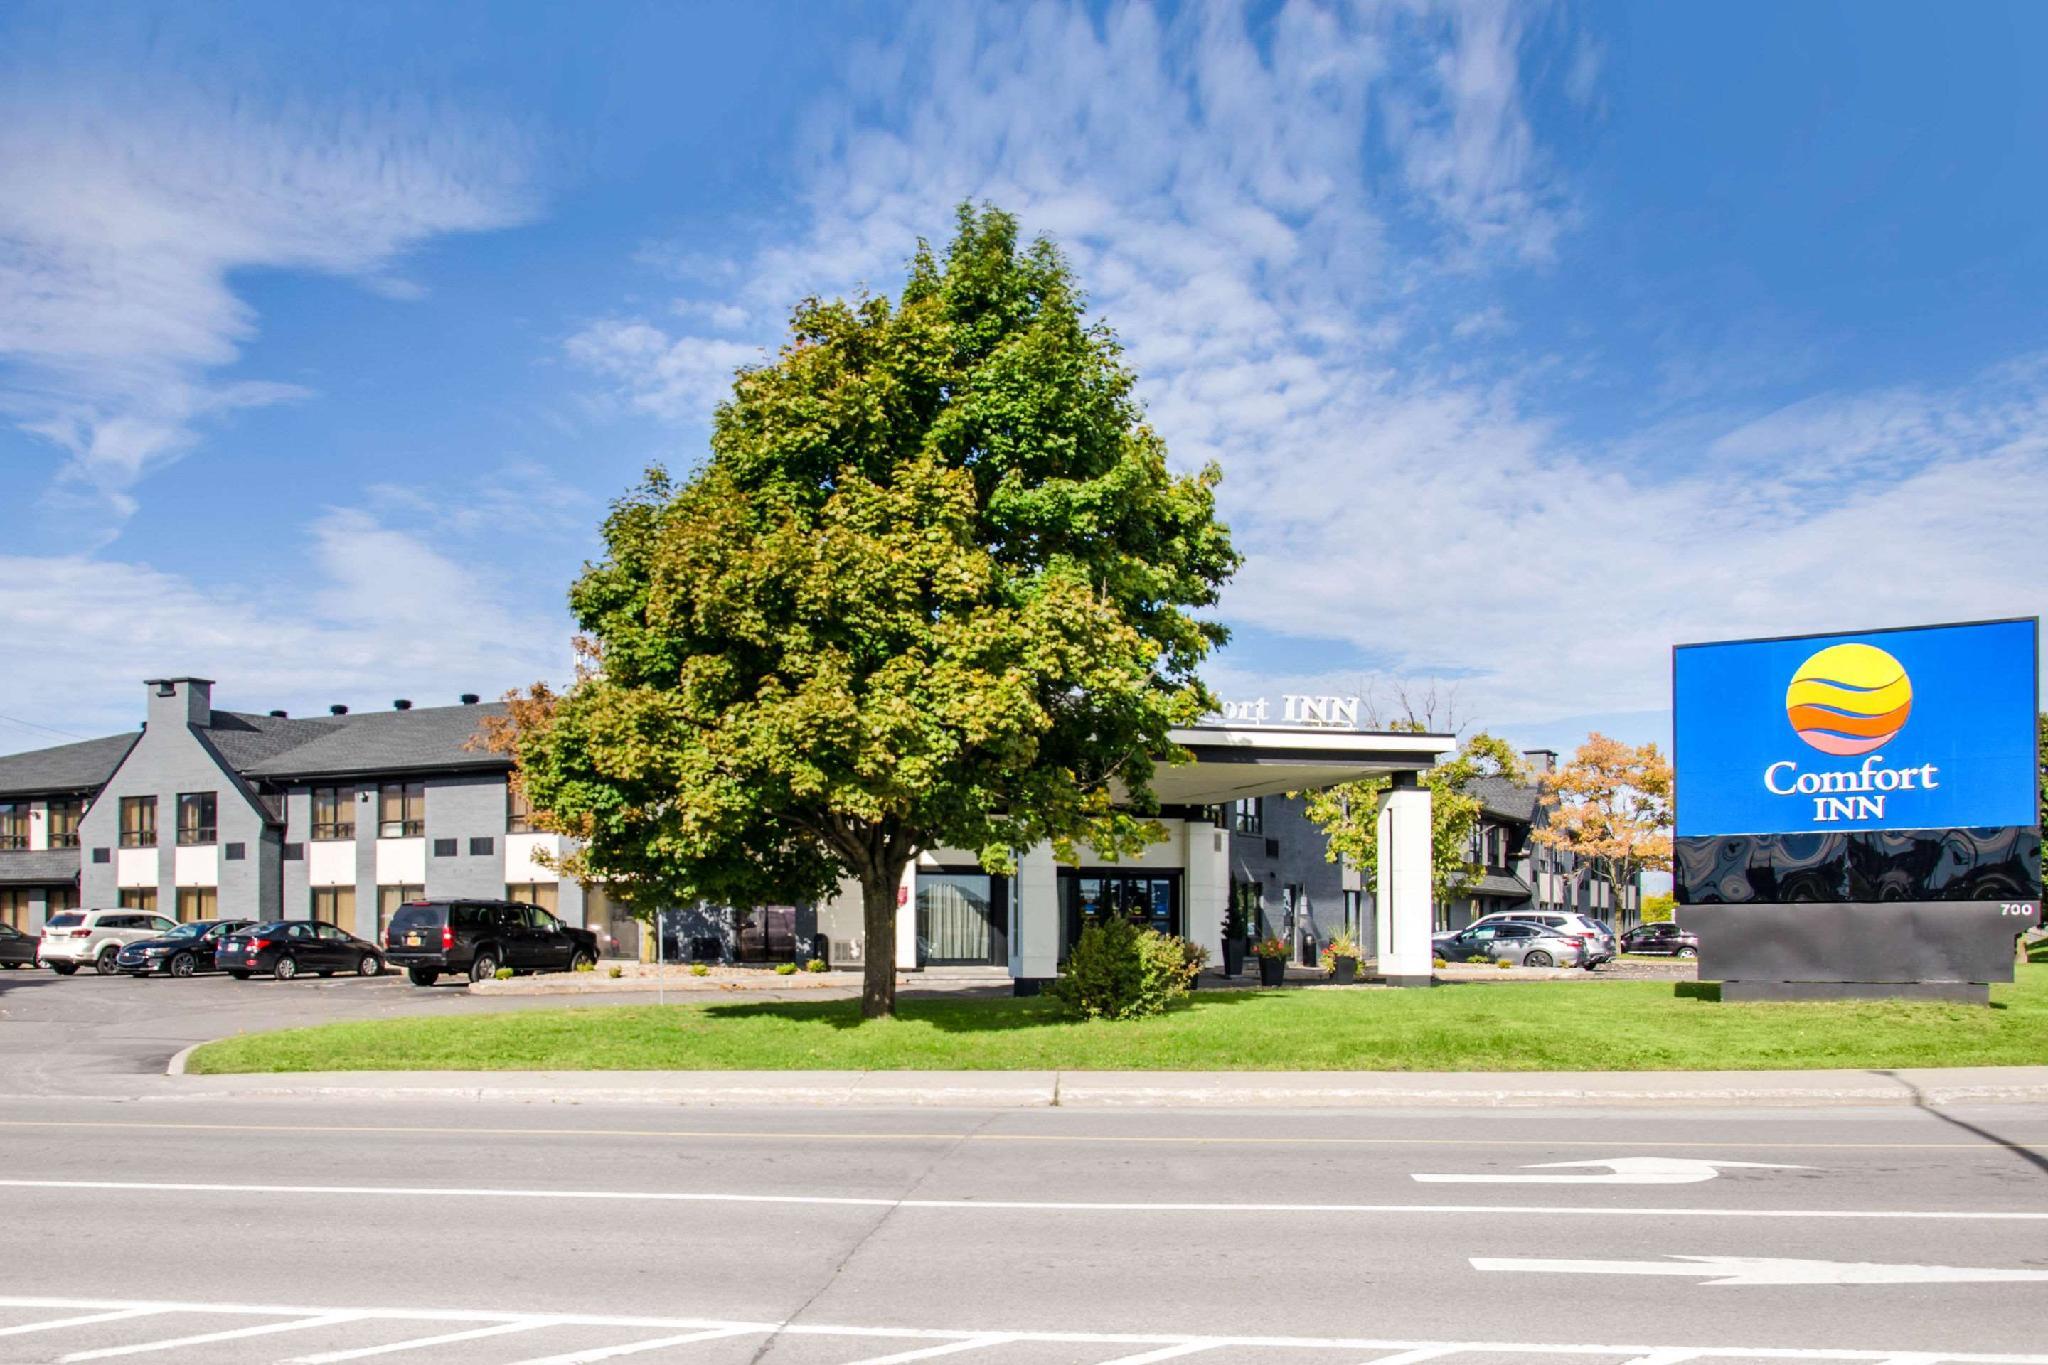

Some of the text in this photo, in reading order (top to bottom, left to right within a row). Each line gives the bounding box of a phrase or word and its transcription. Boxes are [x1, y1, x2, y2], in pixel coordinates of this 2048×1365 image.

[1217, 691, 1360, 724] ort INN
[1763, 755, 1940, 796] Comfort
[1812, 795, 1886, 821] INN
[2000, 903, 2033, 916] 700
